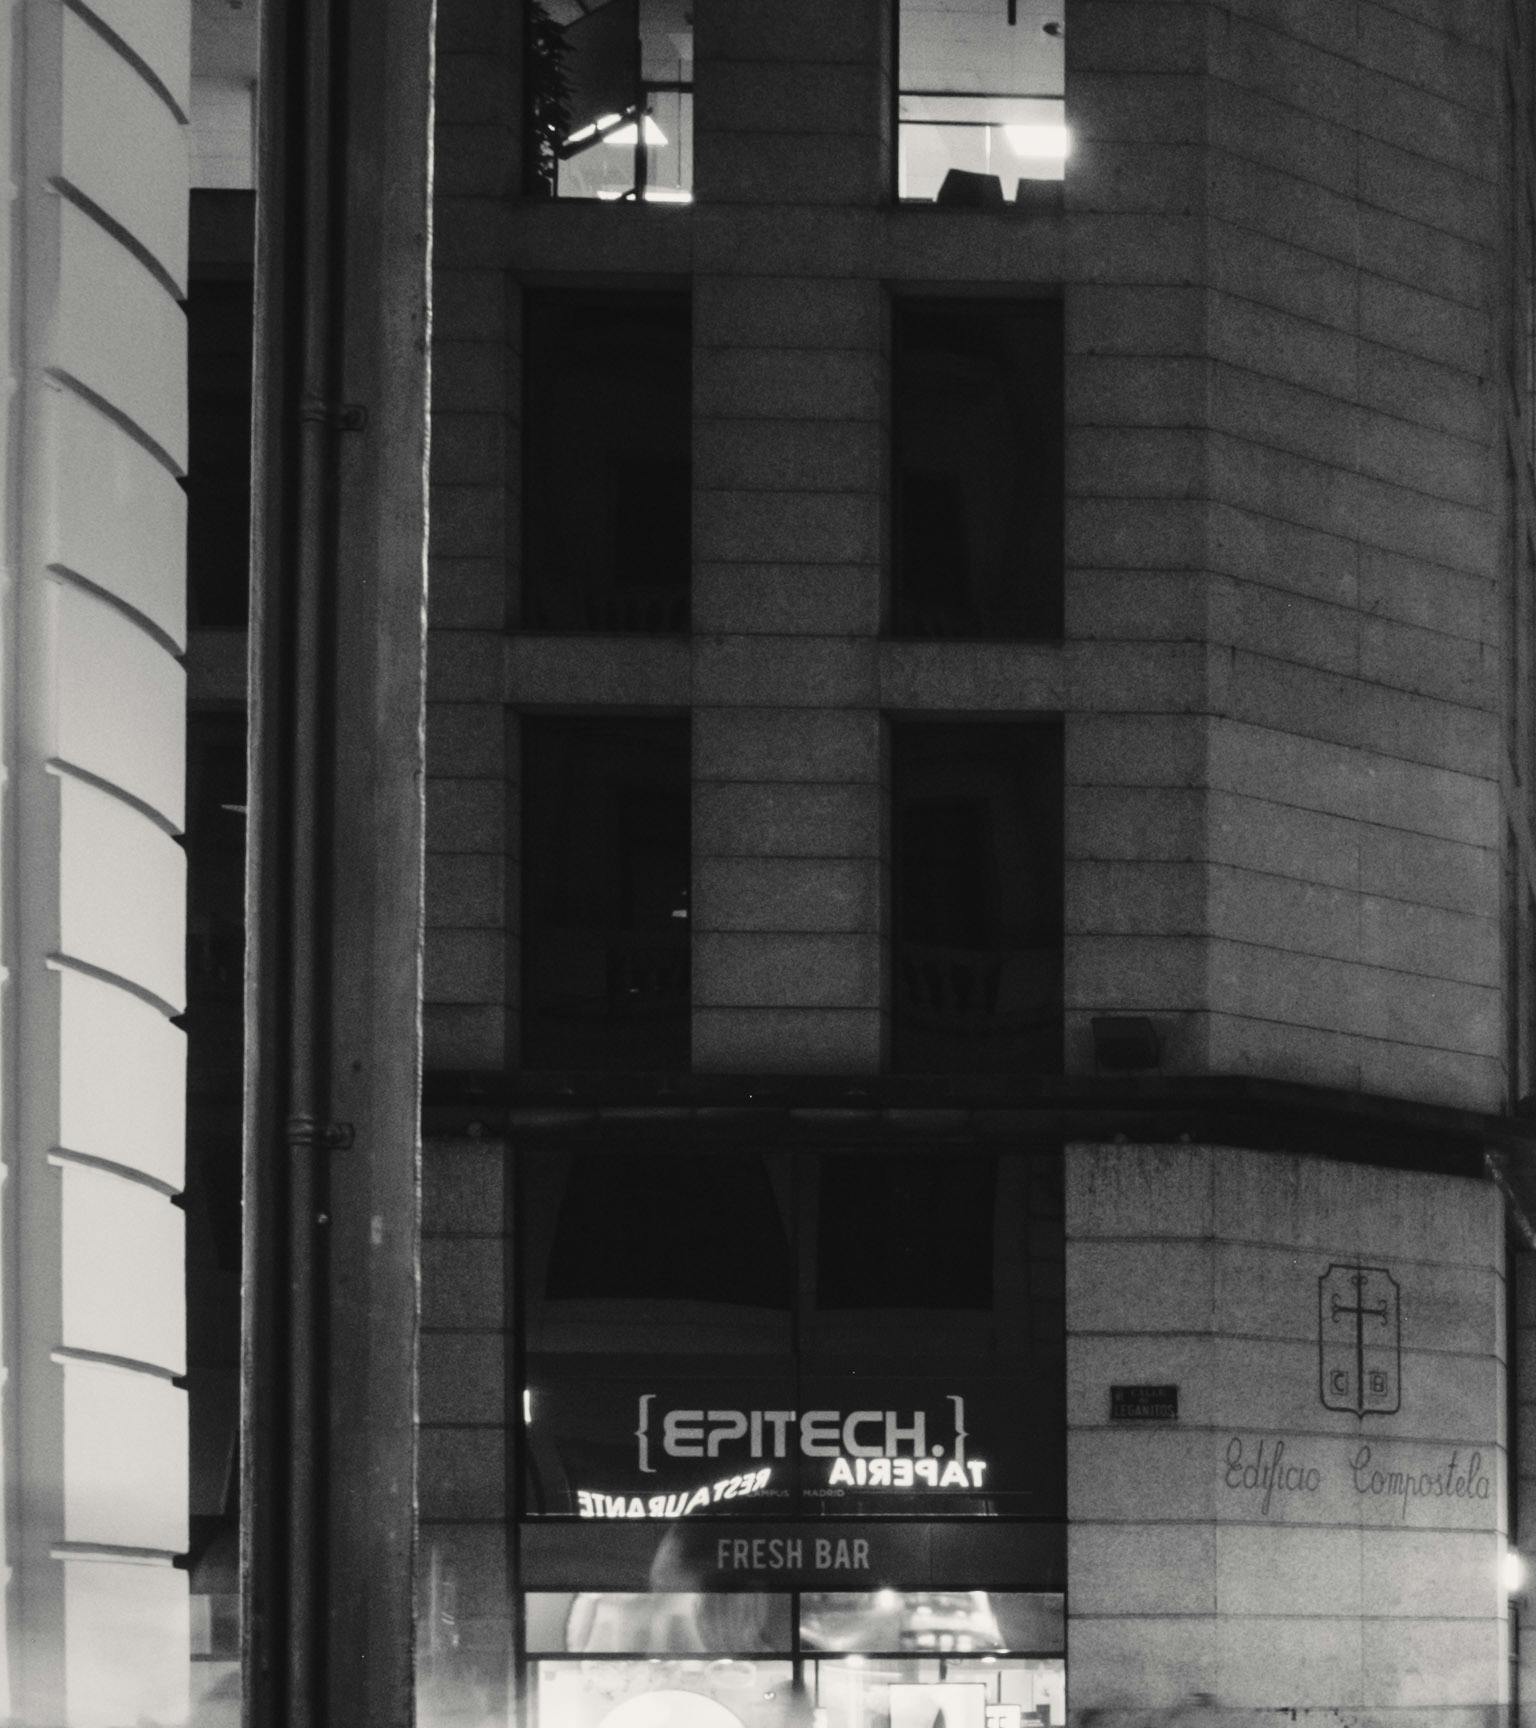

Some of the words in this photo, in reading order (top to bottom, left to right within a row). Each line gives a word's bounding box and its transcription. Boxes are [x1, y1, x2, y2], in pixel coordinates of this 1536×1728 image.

[1114, 1404, 1177, 1418] LEGANITOS
[1225, 1436, 1321, 1515] Edificio
[1350, 1445, 1490, 1520] Compostela
[802, 1489, 846, 1498] MADRID
[717, 1539, 801, 1569] FRESH
[815, 1539, 870, 1569] BAR
